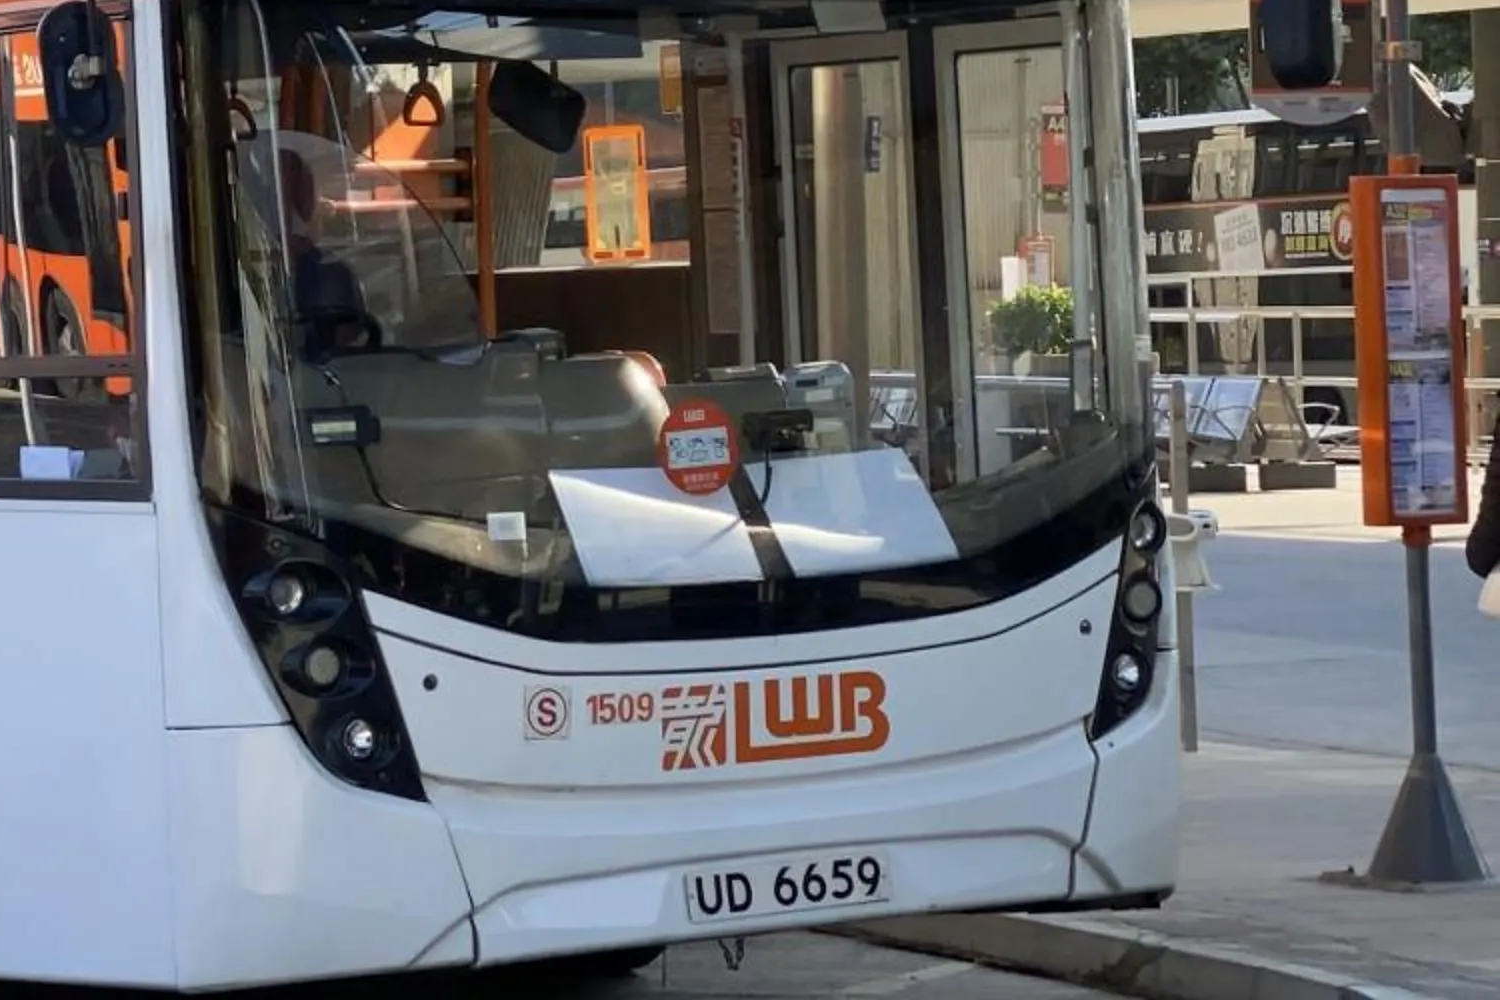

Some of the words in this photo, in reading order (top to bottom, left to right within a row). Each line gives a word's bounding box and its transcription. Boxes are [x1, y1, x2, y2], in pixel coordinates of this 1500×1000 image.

[537, 698, 557, 727] S
[586, 692, 654, 725] 1509
[733, 670, 891, 764] LWB
[696, 872, 753, 915] UD
[774, 856, 882, 906] 6659
